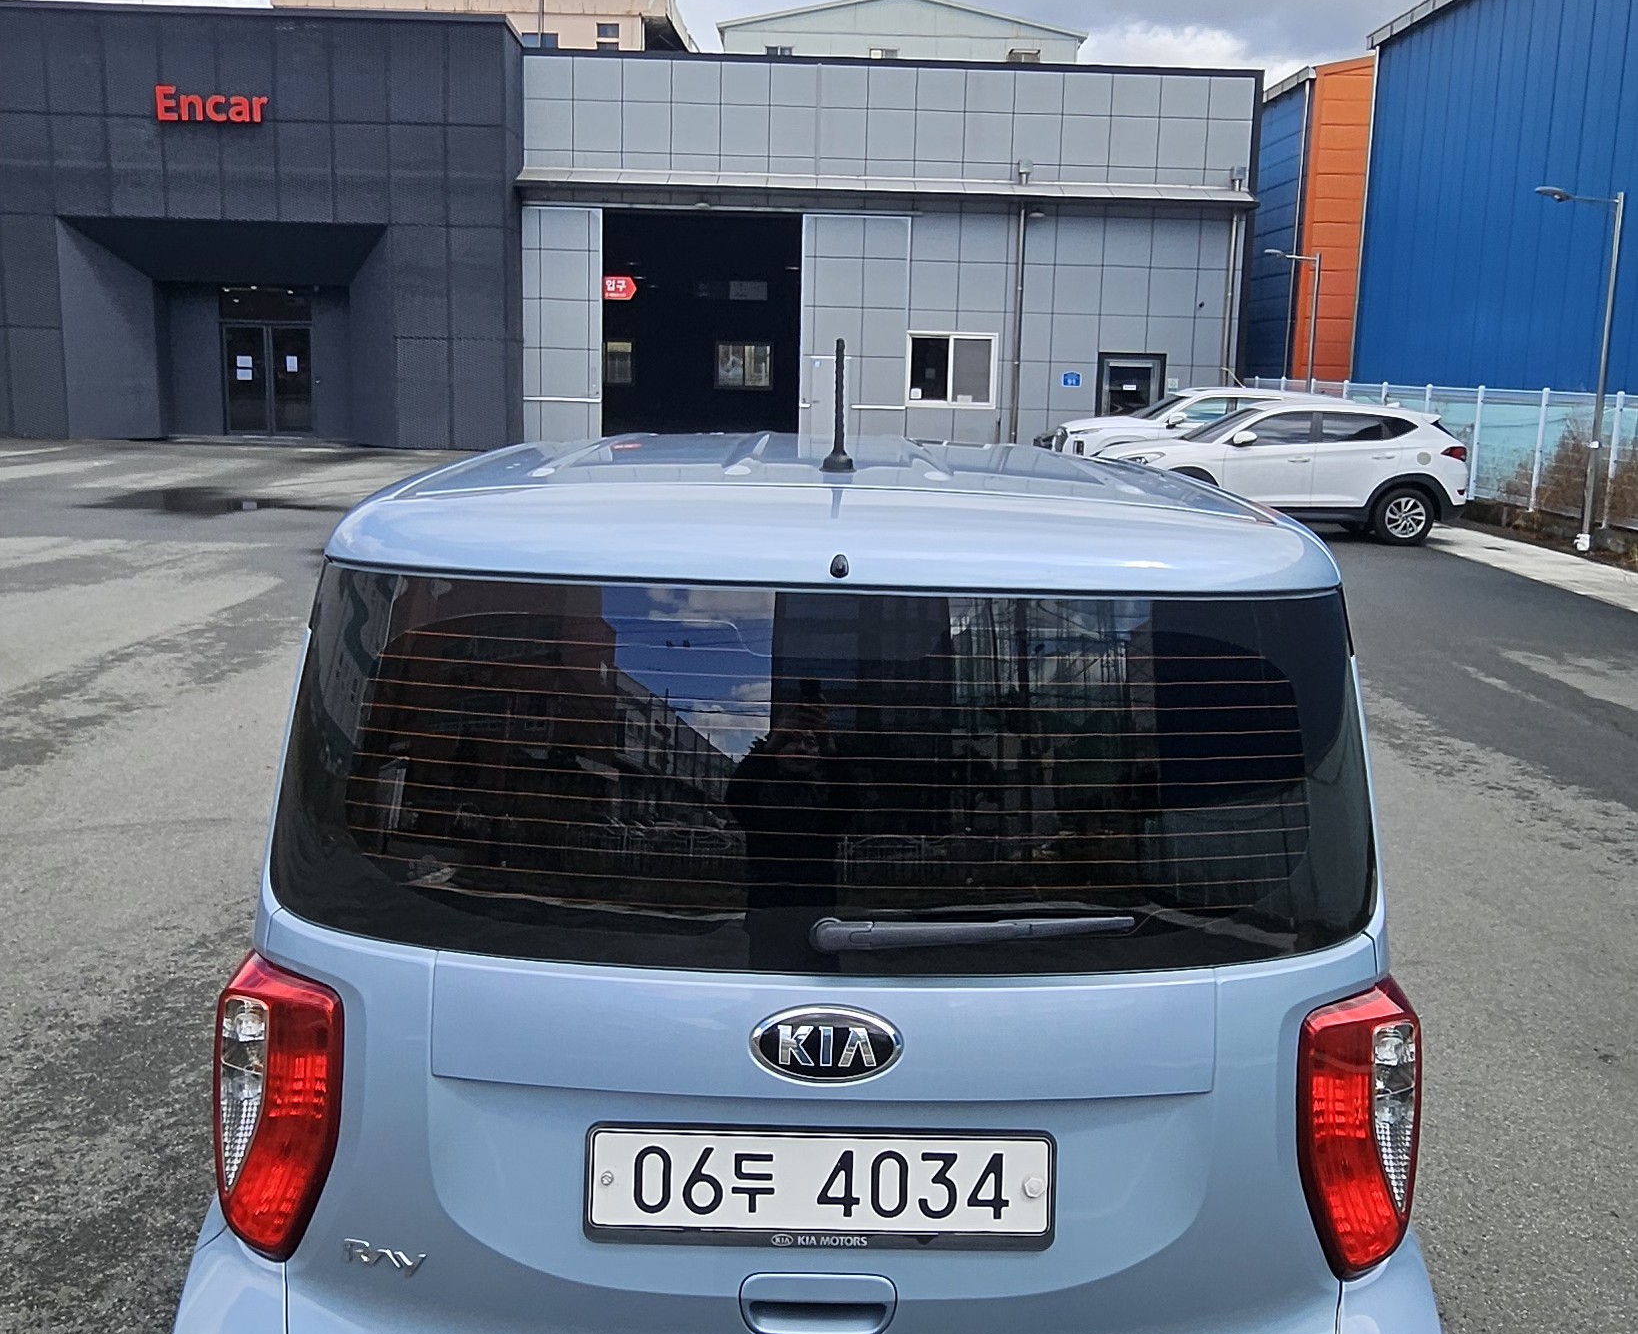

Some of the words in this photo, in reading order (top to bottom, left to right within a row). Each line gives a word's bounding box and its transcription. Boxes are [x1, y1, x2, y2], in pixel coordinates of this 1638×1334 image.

[156, 86, 268, 123] Encar
[605, 279, 627, 292] 입구
[777, 1024, 877, 1067] KIA
[633, 1145, 775, 1215] 06두
[816, 1149, 1010, 1220] 4034
[797, 1236, 817, 1246] KIA
[820, 1236, 867, 1247] MOTORS
